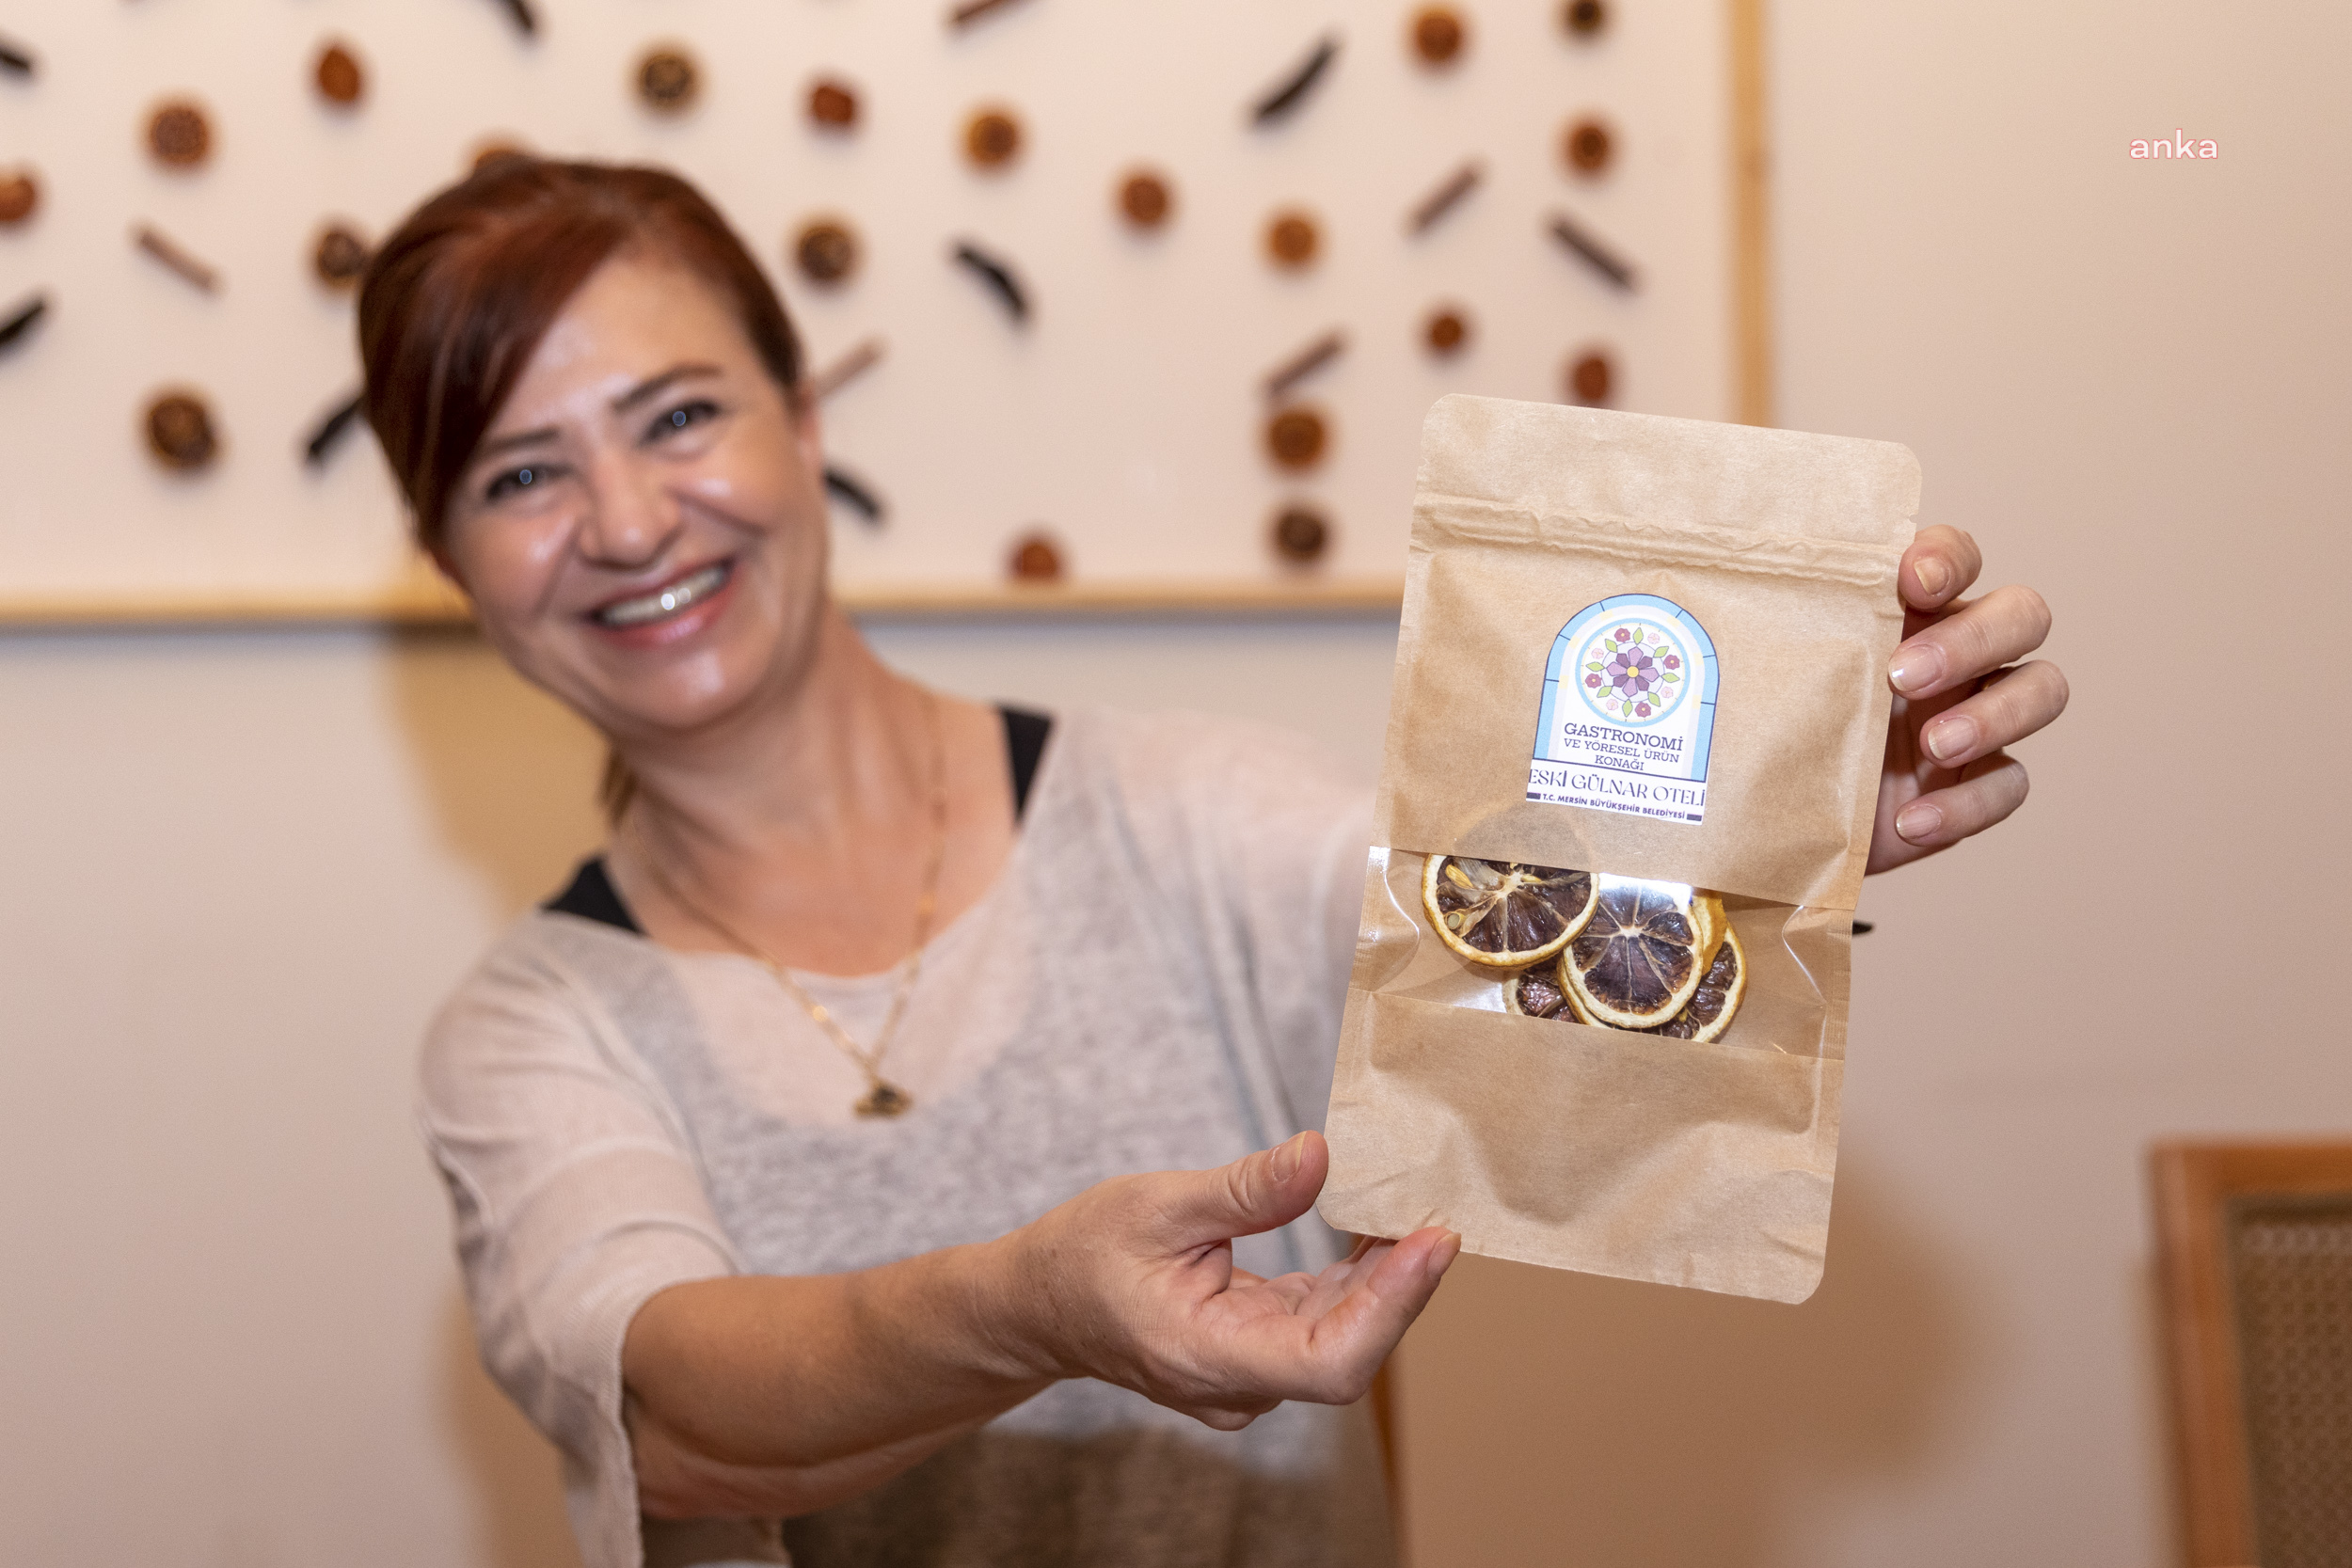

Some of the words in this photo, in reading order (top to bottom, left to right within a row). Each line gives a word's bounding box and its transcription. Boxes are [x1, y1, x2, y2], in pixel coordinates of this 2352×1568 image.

[1564, 722, 1684, 752] GASTRONOMİ
[1564, 737, 1581, 749] VE
[1584, 738, 1641, 758] YÖRESEL
[1644, 748, 1680, 764] ÜRÜN
[1595, 754, 1645, 771] KONAĞI
[1571, 773, 1647, 800] GÜLNAR
[1653, 785, 1706, 807] OTELİ
[1542, 794, 1556, 802] T.C.
[1557, 795, 1588, 806] MERSİN
[1590, 798, 1641, 814] BÜYÜKŞEHİR
[1642, 807, 1686, 820] BELEDİYESİ
